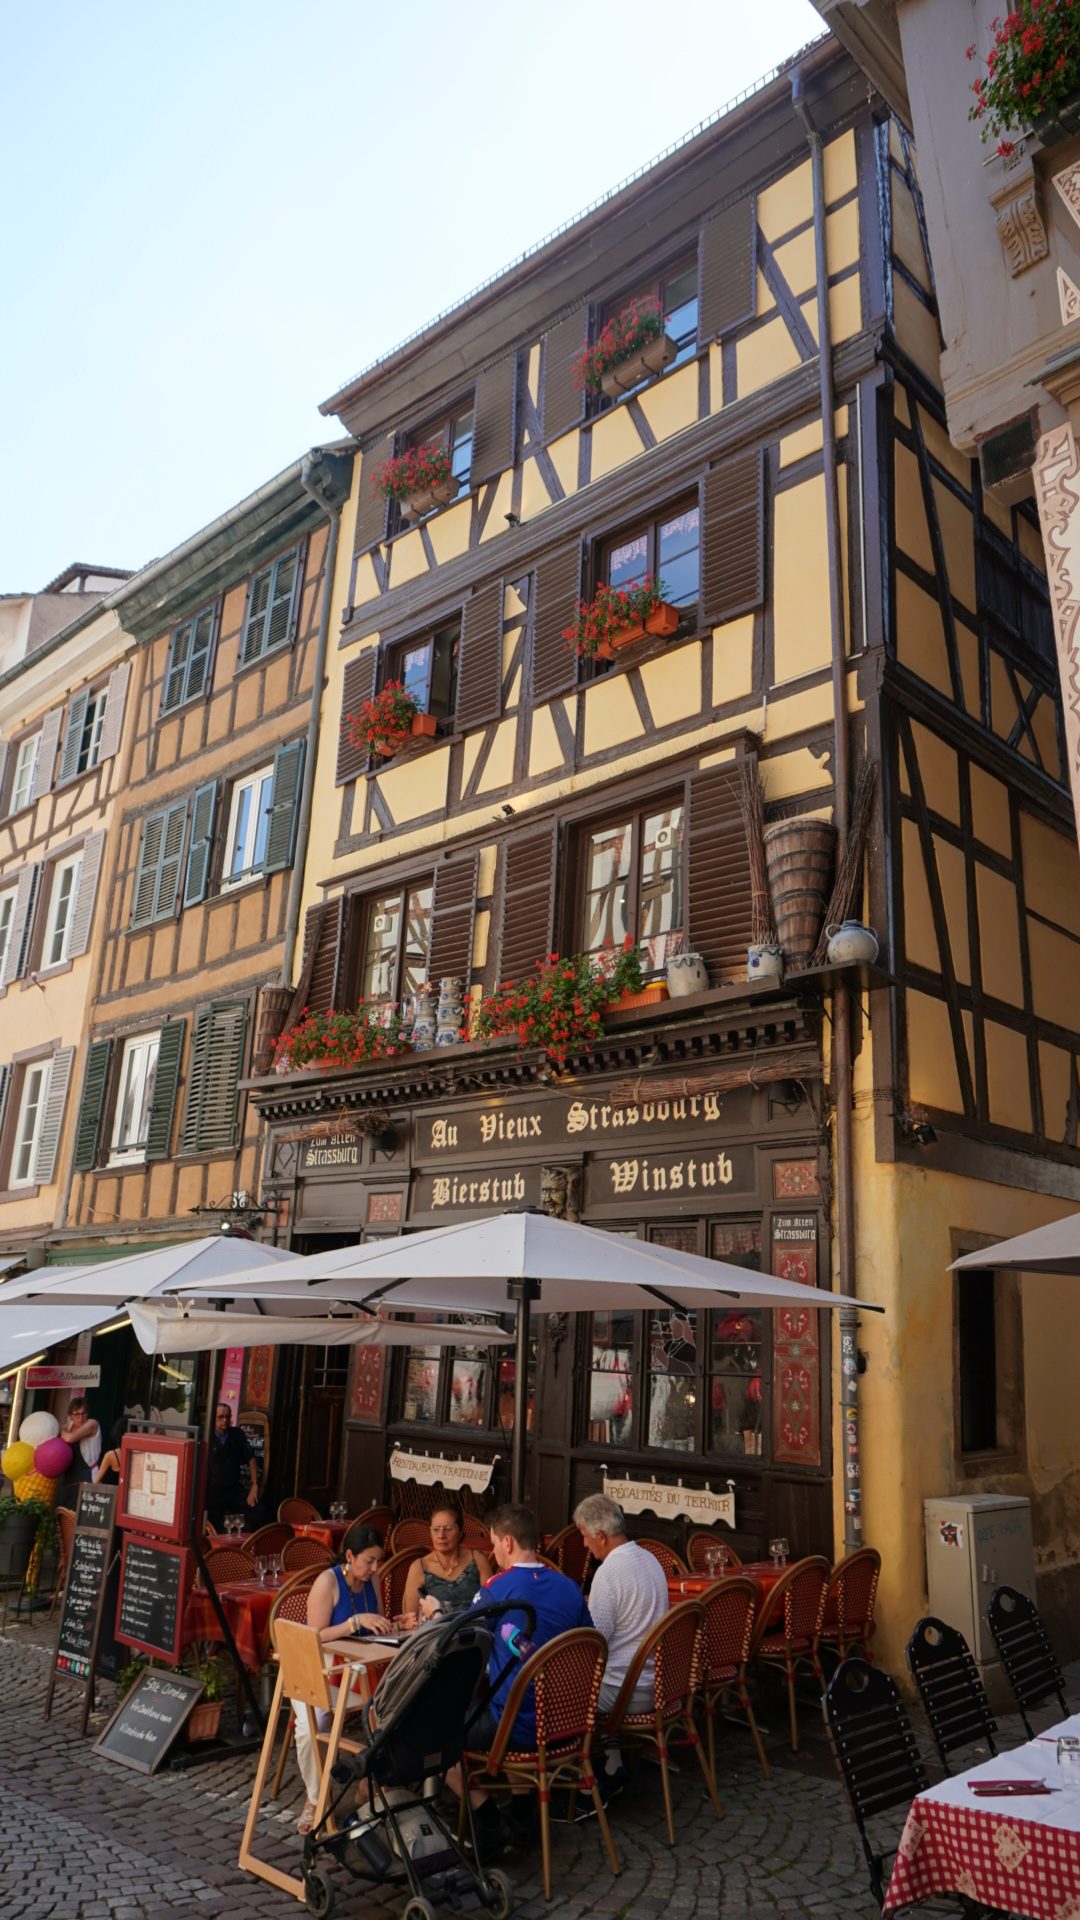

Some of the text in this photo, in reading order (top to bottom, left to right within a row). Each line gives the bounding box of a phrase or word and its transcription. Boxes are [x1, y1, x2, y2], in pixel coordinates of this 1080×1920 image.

[431, 1091, 720, 1148] Au Vieux Strasbourg
[305, 1146, 358, 1167] Strassburg
[610, 1152, 733, 1194] Winstub
[431, 1172, 525, 1209] Bierstub
[774, 1229, 816, 1240] Strassburg
[667, 1492, 680, 1506] DU
